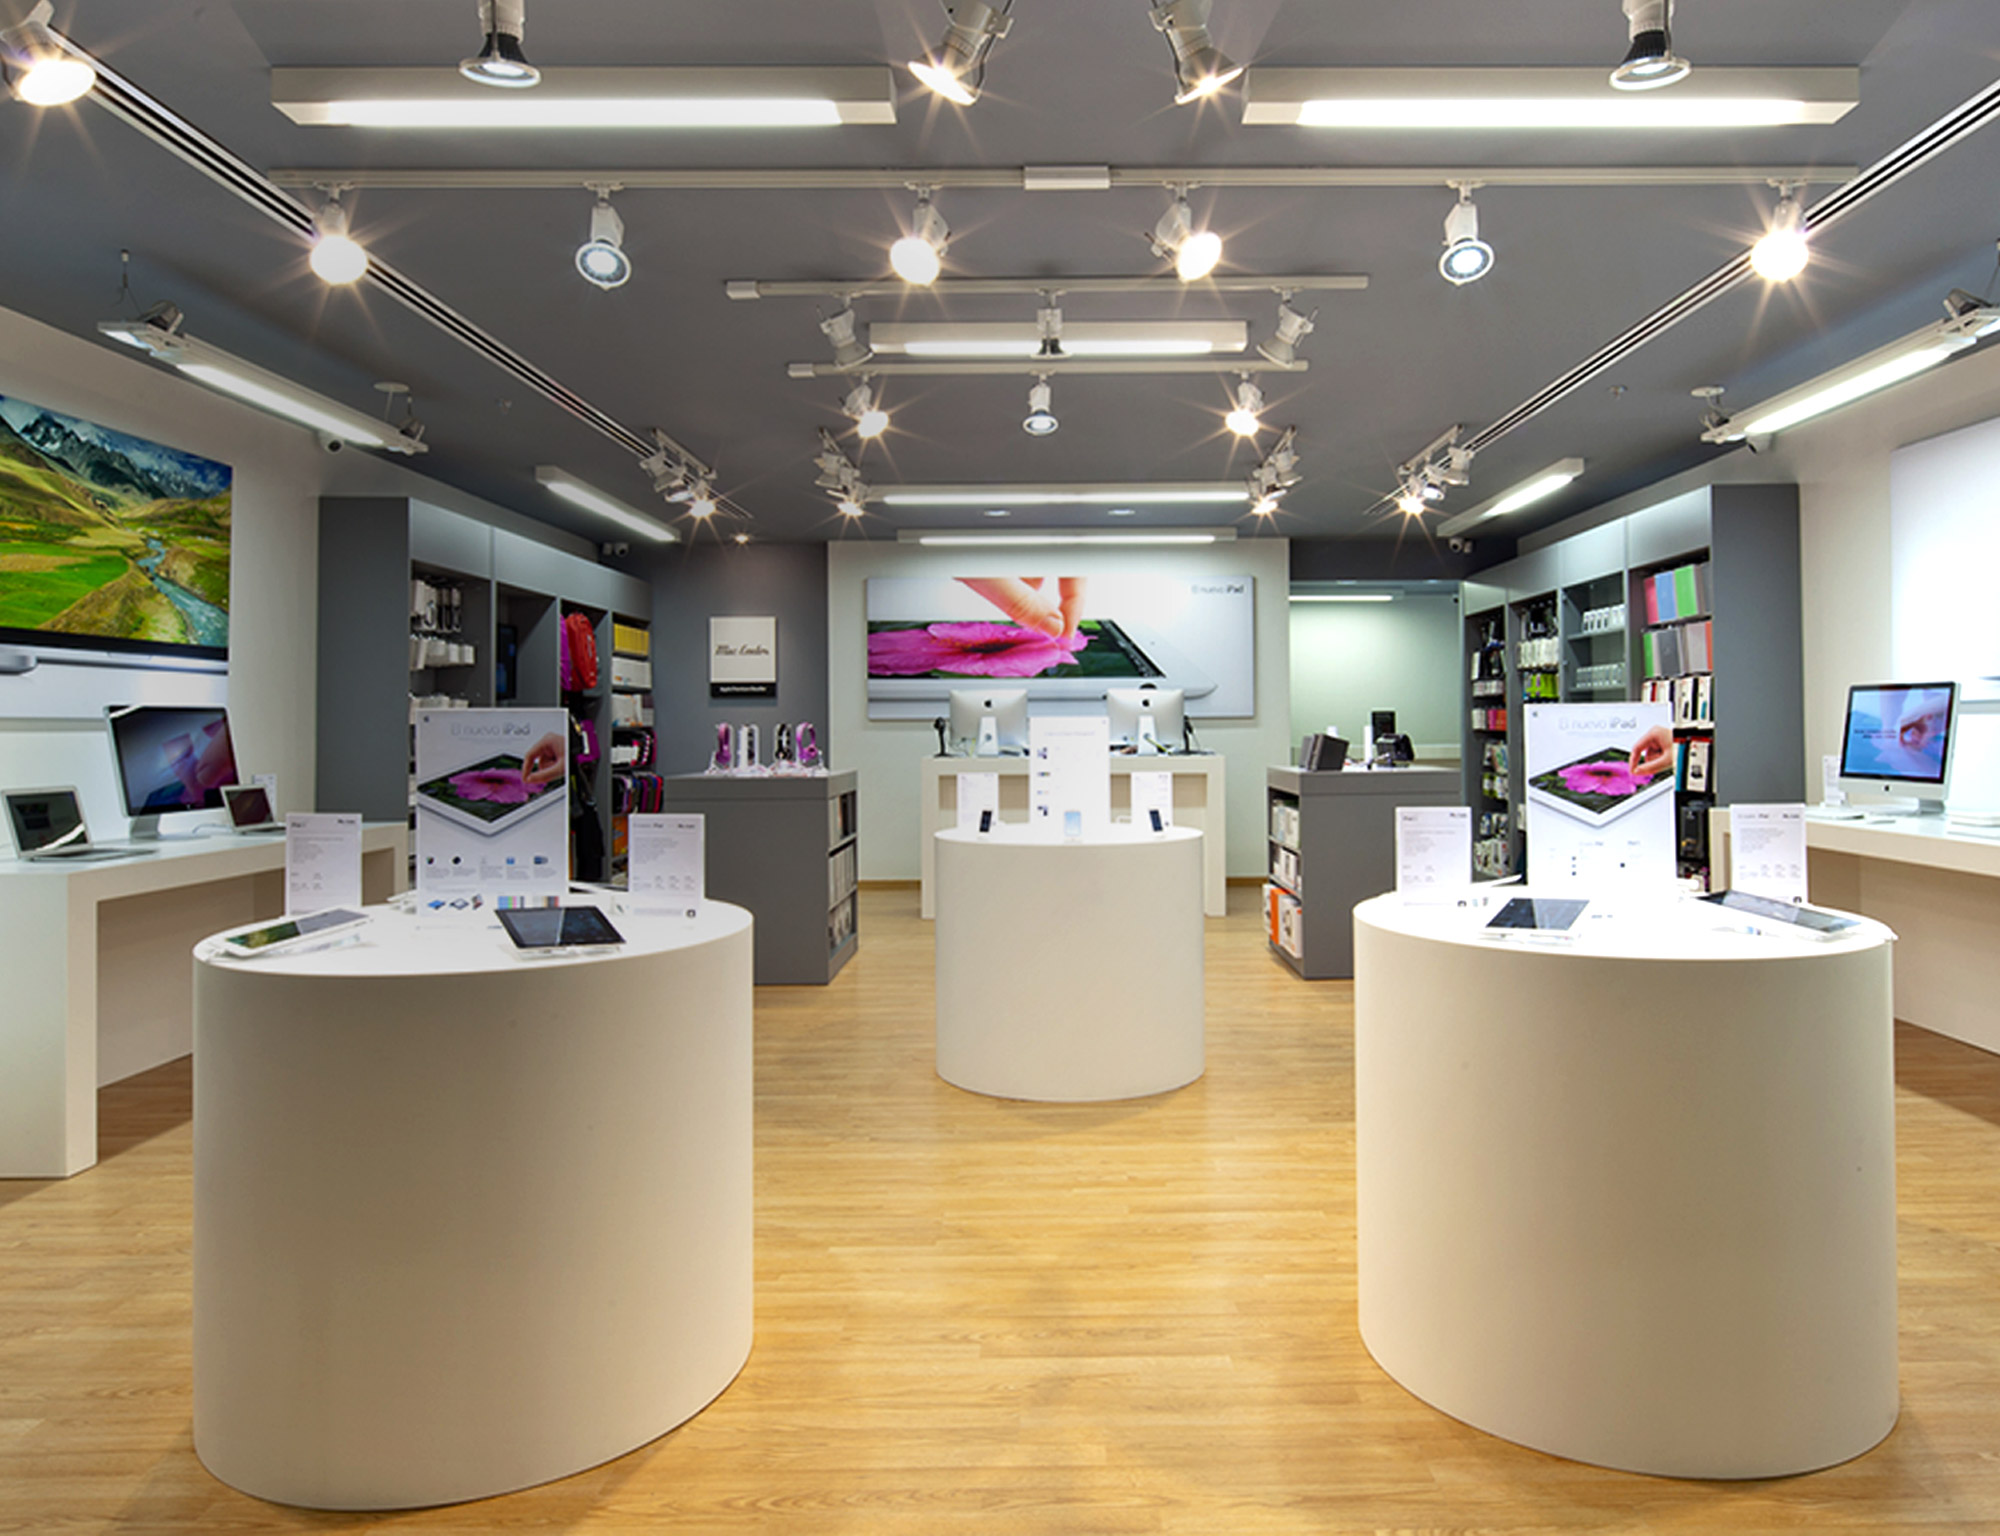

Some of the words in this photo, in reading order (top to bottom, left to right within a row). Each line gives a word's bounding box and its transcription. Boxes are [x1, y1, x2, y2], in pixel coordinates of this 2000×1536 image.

[463, 725, 500, 736] nuevo
[503, 721, 531, 736] iPad
[1572, 719, 1607, 729] nuevo
[1610, 716, 1637, 729] iPad
